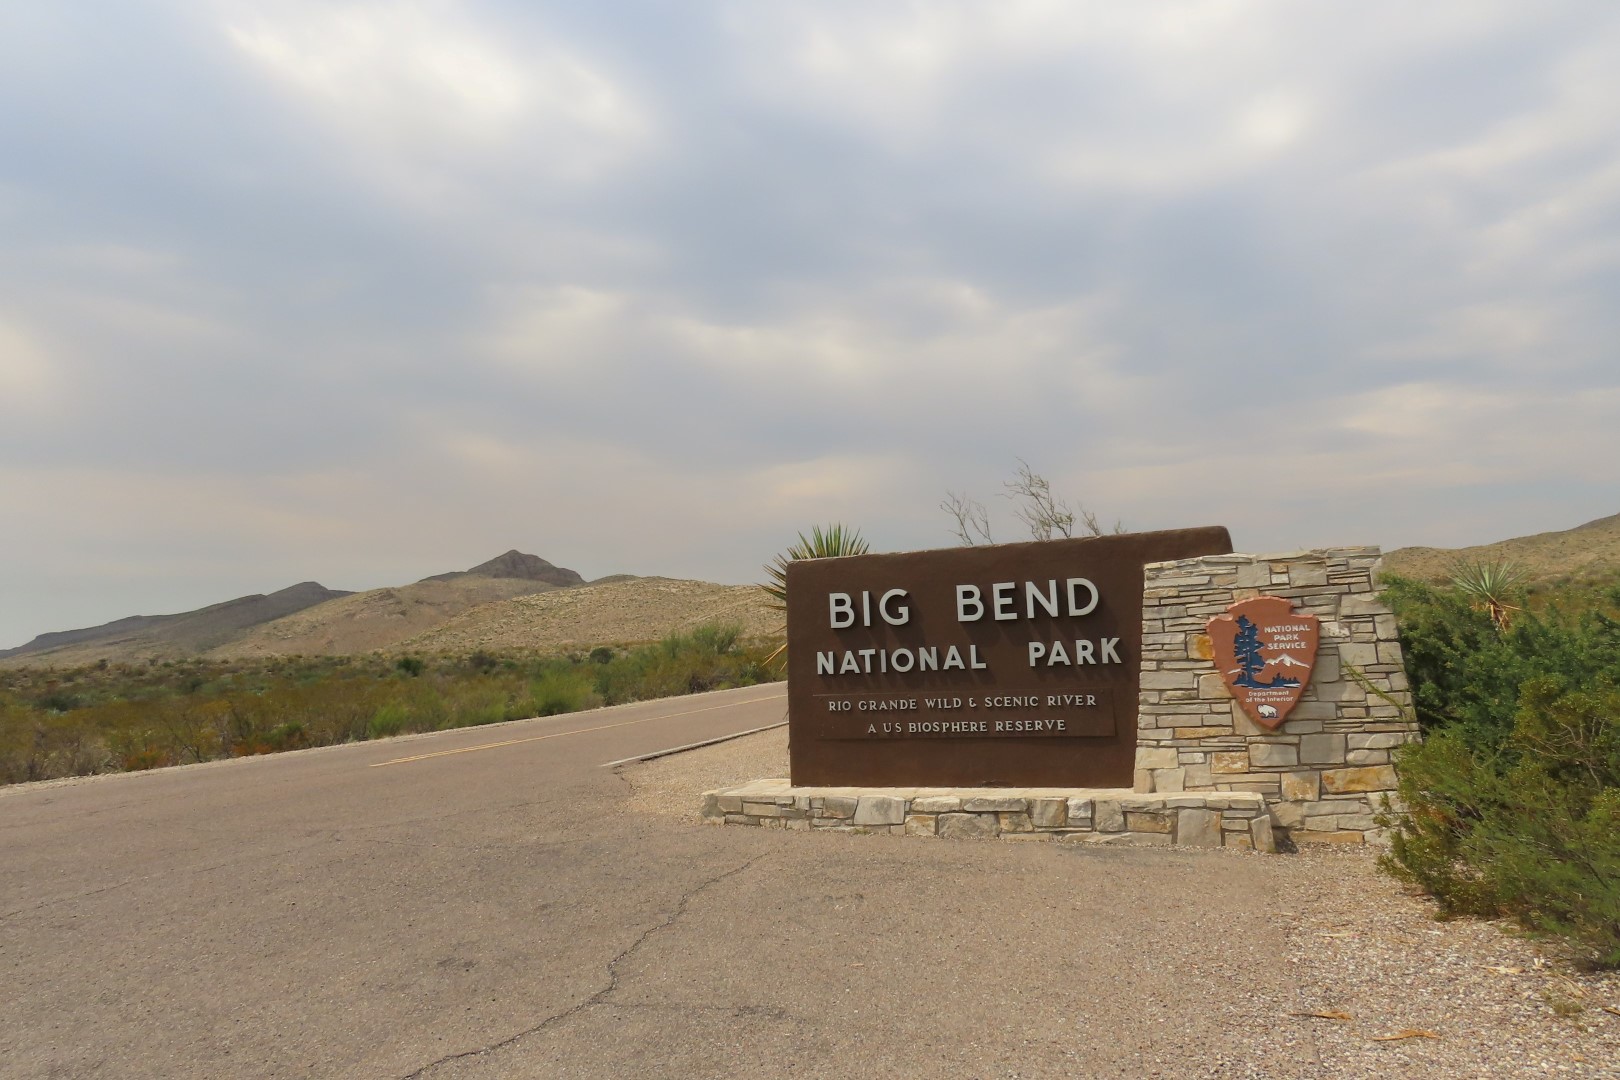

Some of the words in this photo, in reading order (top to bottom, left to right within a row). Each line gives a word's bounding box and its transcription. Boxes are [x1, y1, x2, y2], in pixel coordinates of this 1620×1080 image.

[829, 588, 910, 629] BIG
[956, 577, 1099, 622] BEND
[1264, 624, 1310, 633] NATIONAL
[1267, 641, 1307, 650] SERVICE
[816, 644, 987, 675] NATIONAL
[1028, 637, 1122, 667] PARK
[829, 701, 851, 711] RIO
[858, 699, 917, 711] GRANDE
[925, 697, 962, 708] WILD
[968, 697, 977, 708] &
[984, 696, 1039, 707] SCENIC
[1047, 694, 1097, 706] RIVER
[868, 723, 877, 733] A
[908, 721, 988, 733] BIOSPHERE
[995, 719, 1066, 731] RESERVE
